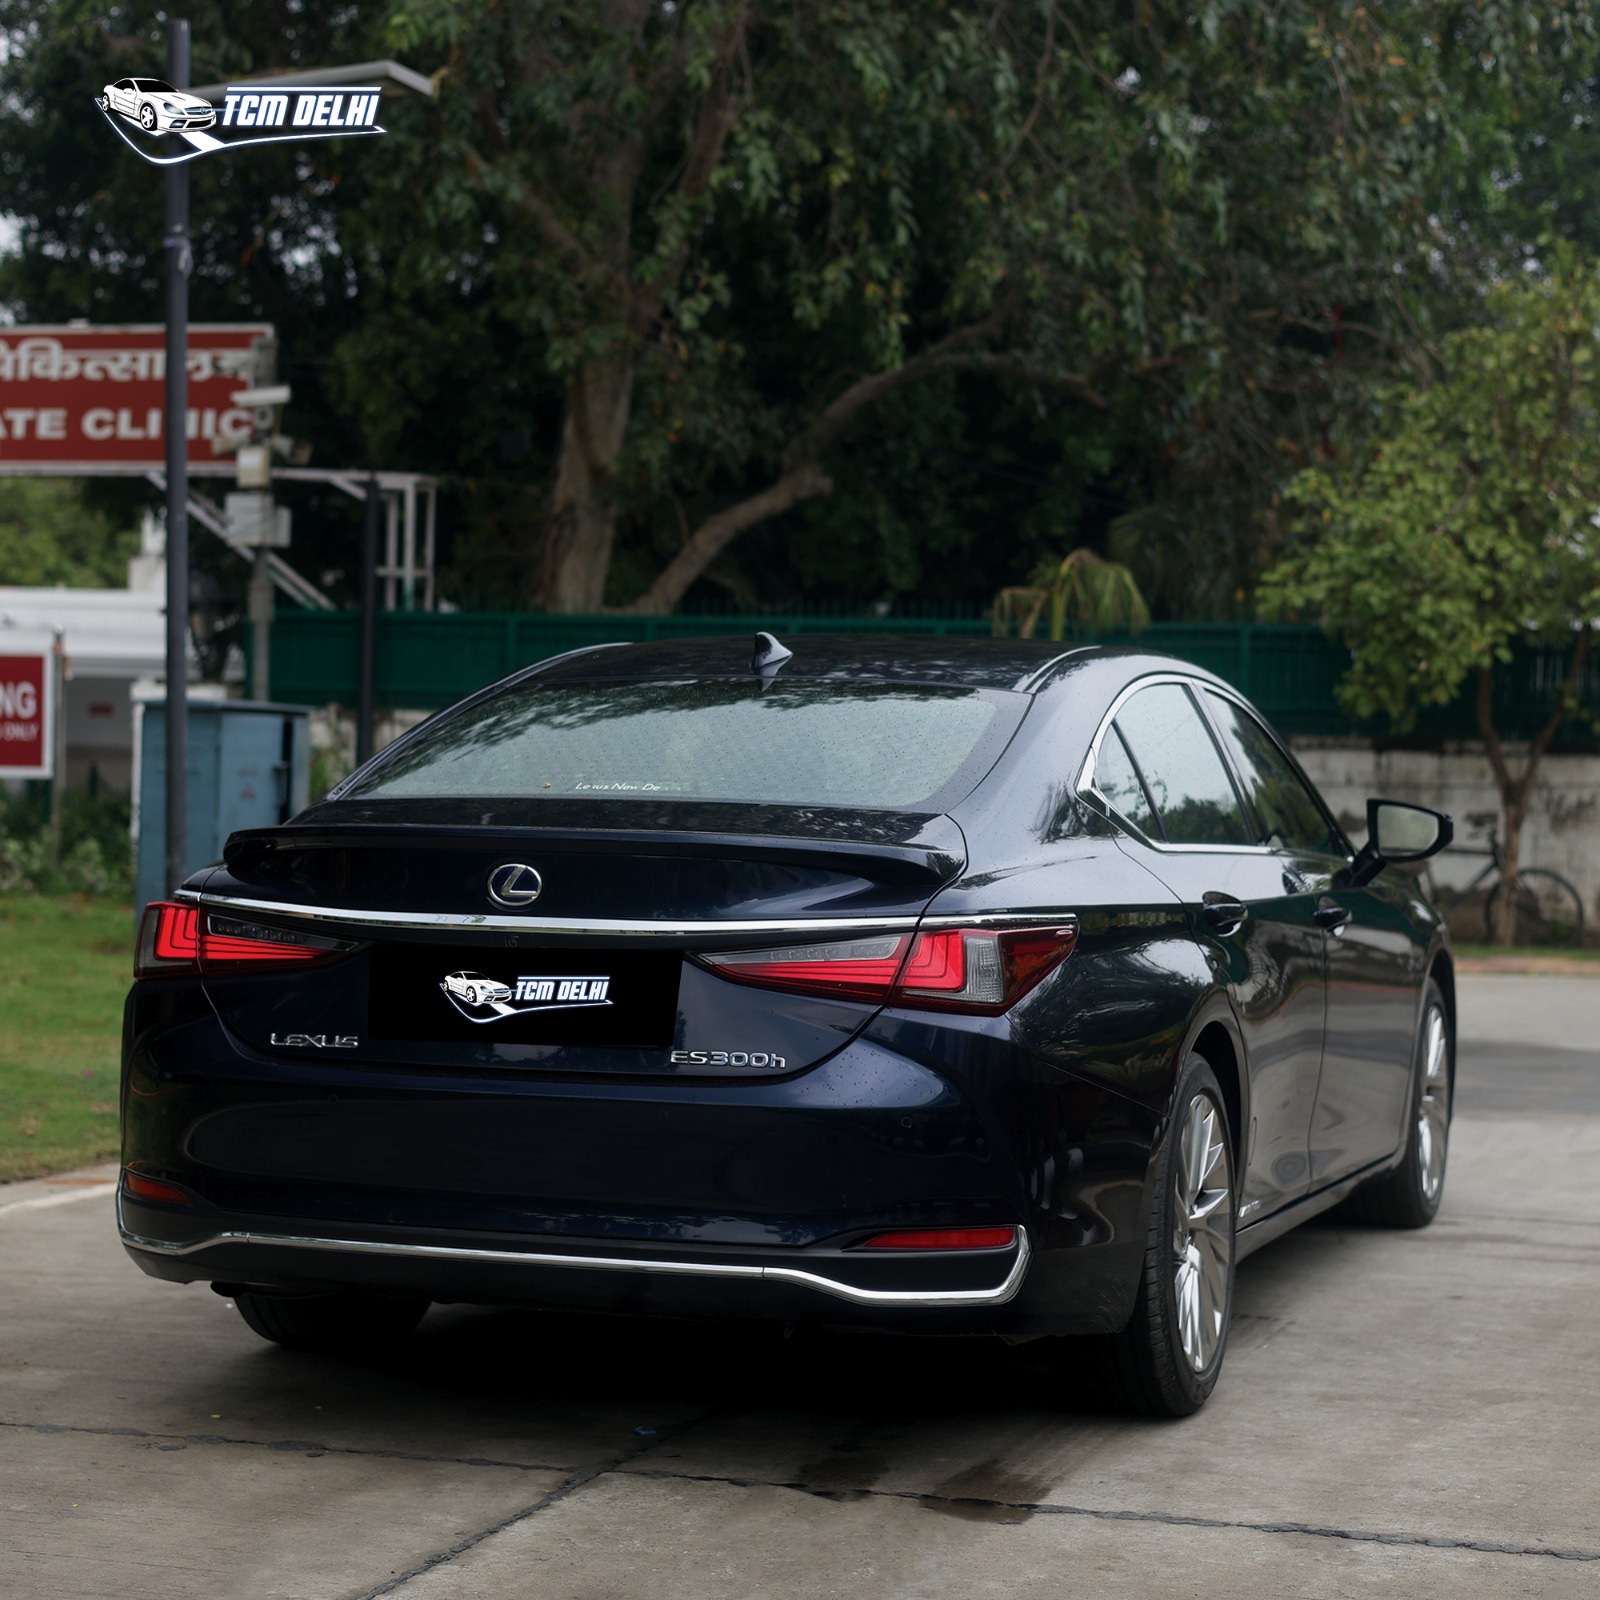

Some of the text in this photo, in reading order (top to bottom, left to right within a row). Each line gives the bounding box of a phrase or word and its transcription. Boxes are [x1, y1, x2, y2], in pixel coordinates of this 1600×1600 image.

[0, 408, 68, 439] TE
[270, 1032, 359, 1048] LEXUS
[670, 1050, 786, 1068] ES300h
